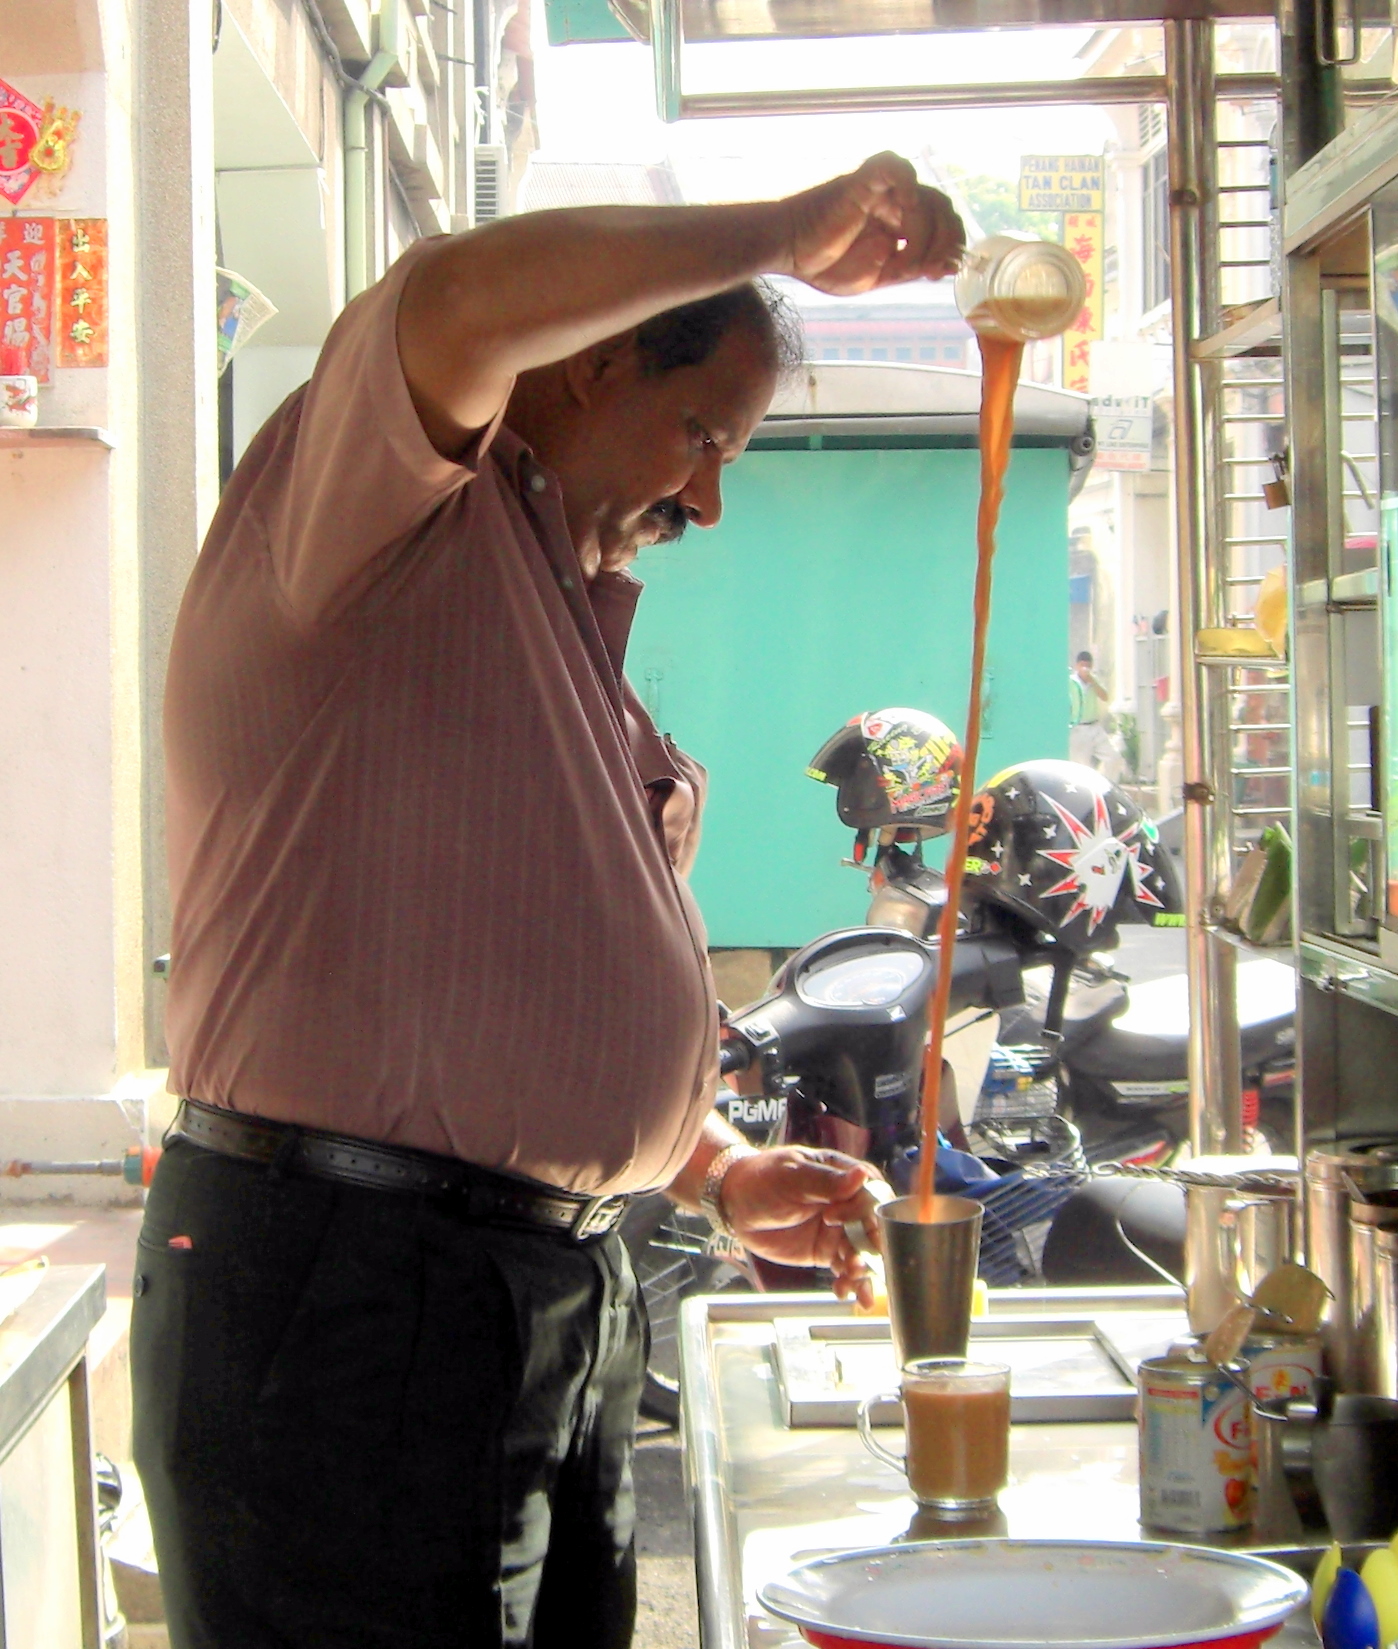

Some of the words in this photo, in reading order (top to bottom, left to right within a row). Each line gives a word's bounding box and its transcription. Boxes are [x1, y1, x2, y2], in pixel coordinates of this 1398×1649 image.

[1023, 175, 1052, 190] TAN
[1059, 175, 1100, 190] CLAN
[1028, 193, 1092, 208] ASSOCIATION
[69, 229, 95, 345] 出入平安
